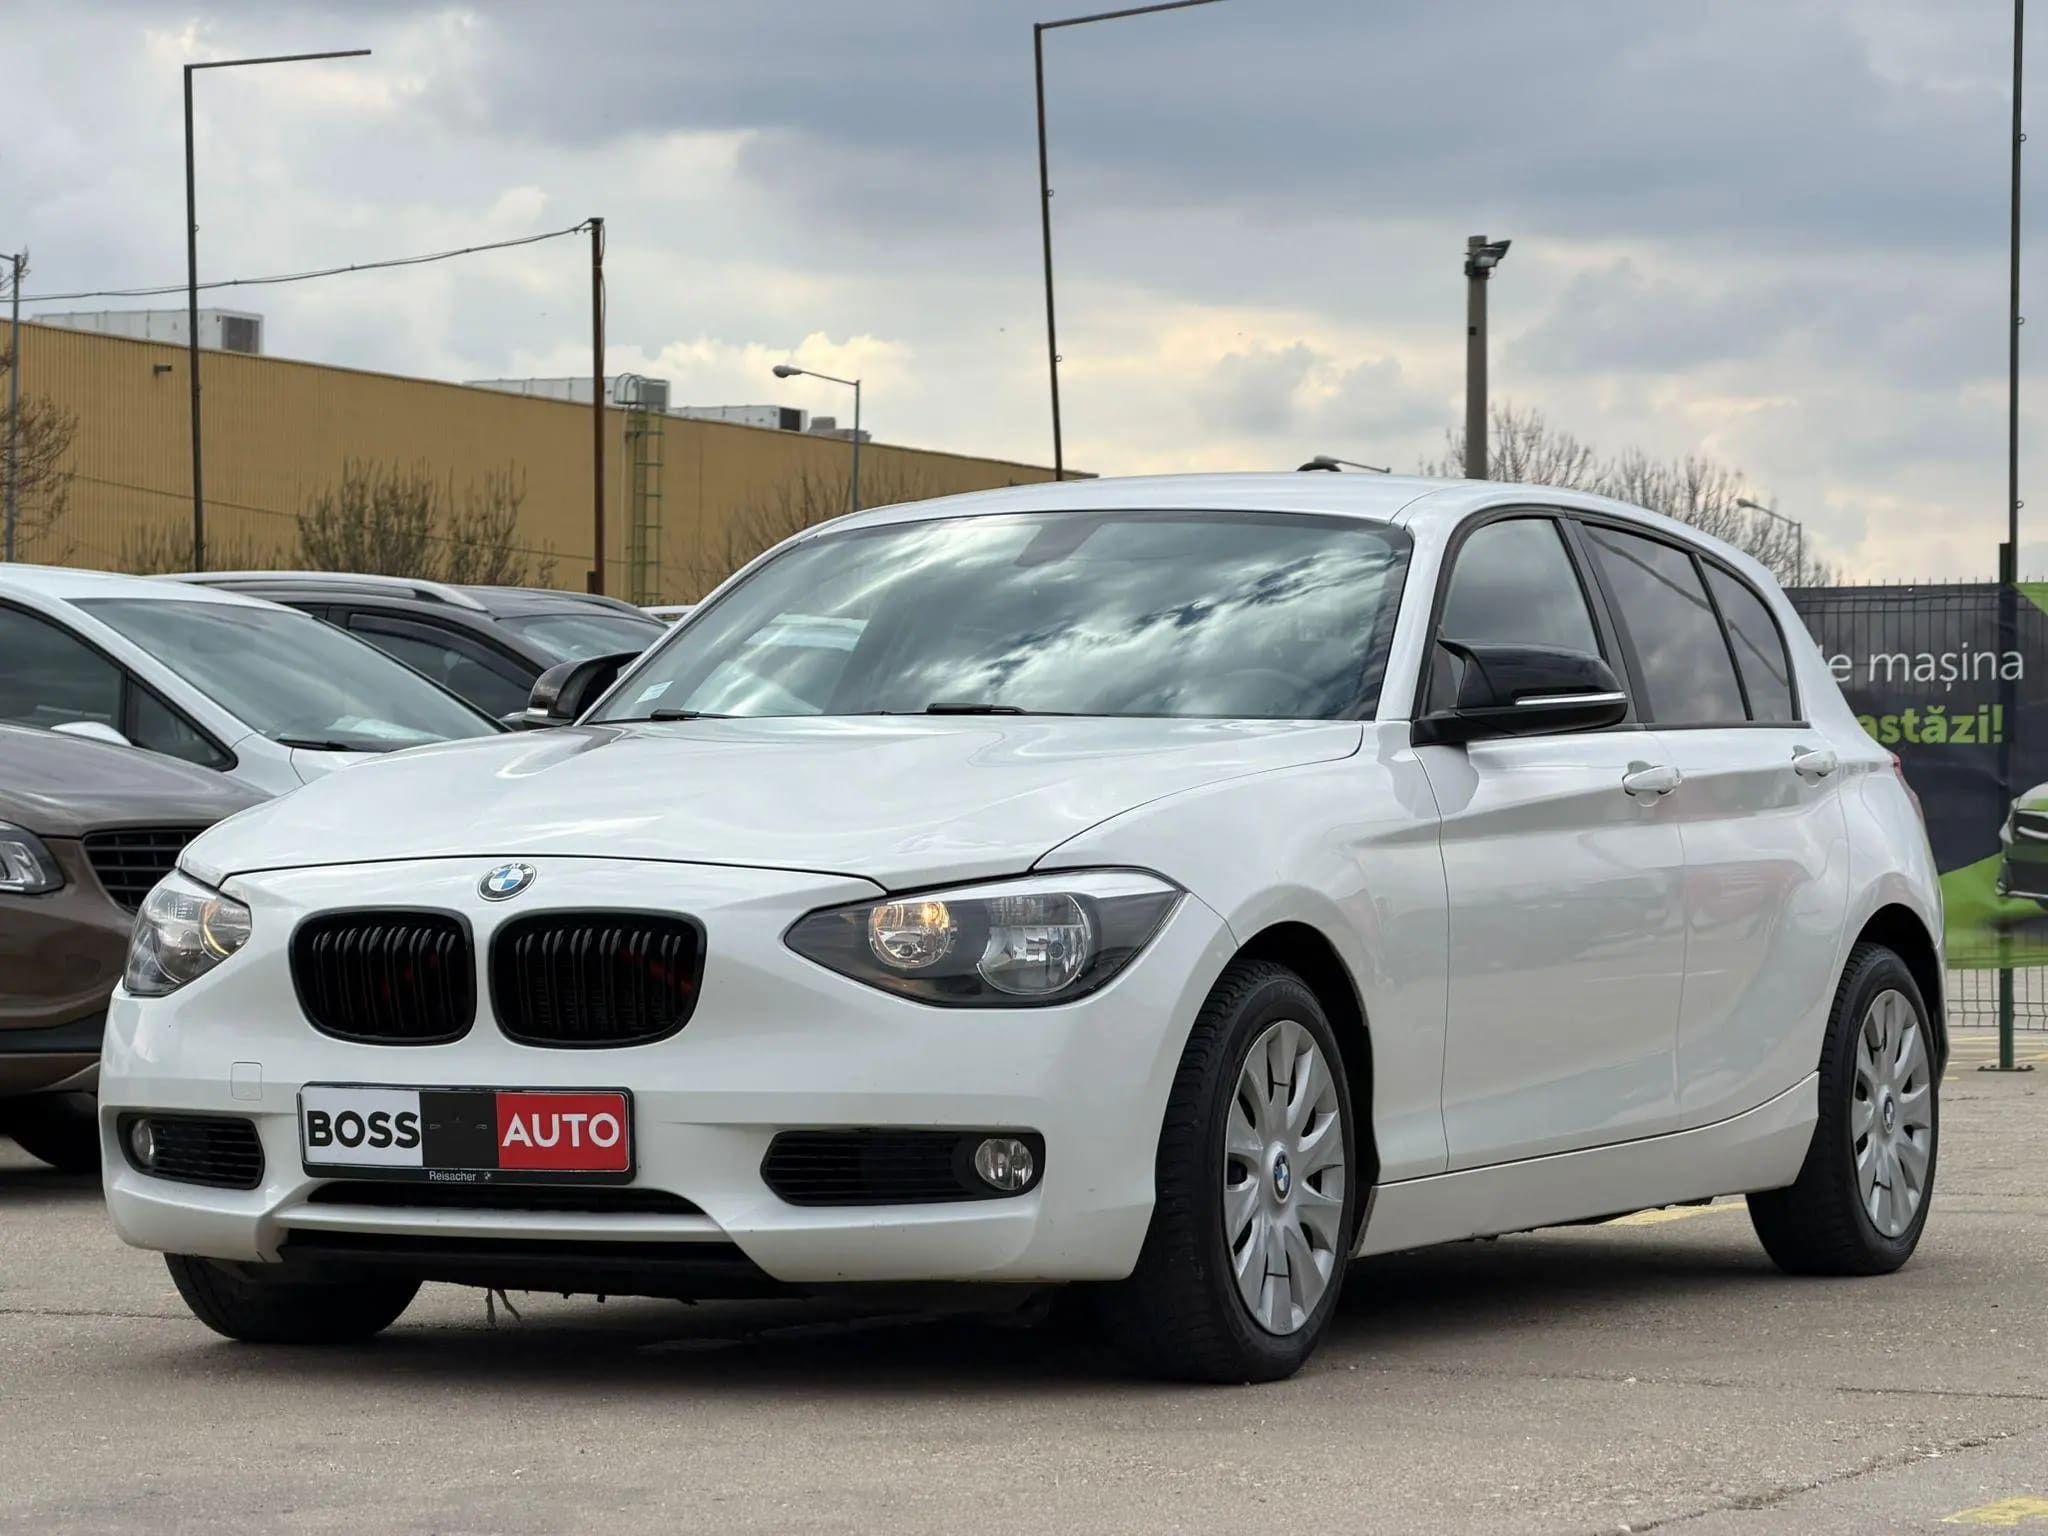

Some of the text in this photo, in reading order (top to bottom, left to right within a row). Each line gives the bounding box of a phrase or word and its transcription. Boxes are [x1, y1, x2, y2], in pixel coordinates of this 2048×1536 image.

[1817, 641, 2024, 692] e mașina
[306, 1109, 620, 1149] BOSS AUTO
[429, 1170, 477, 1182] Reisacher
